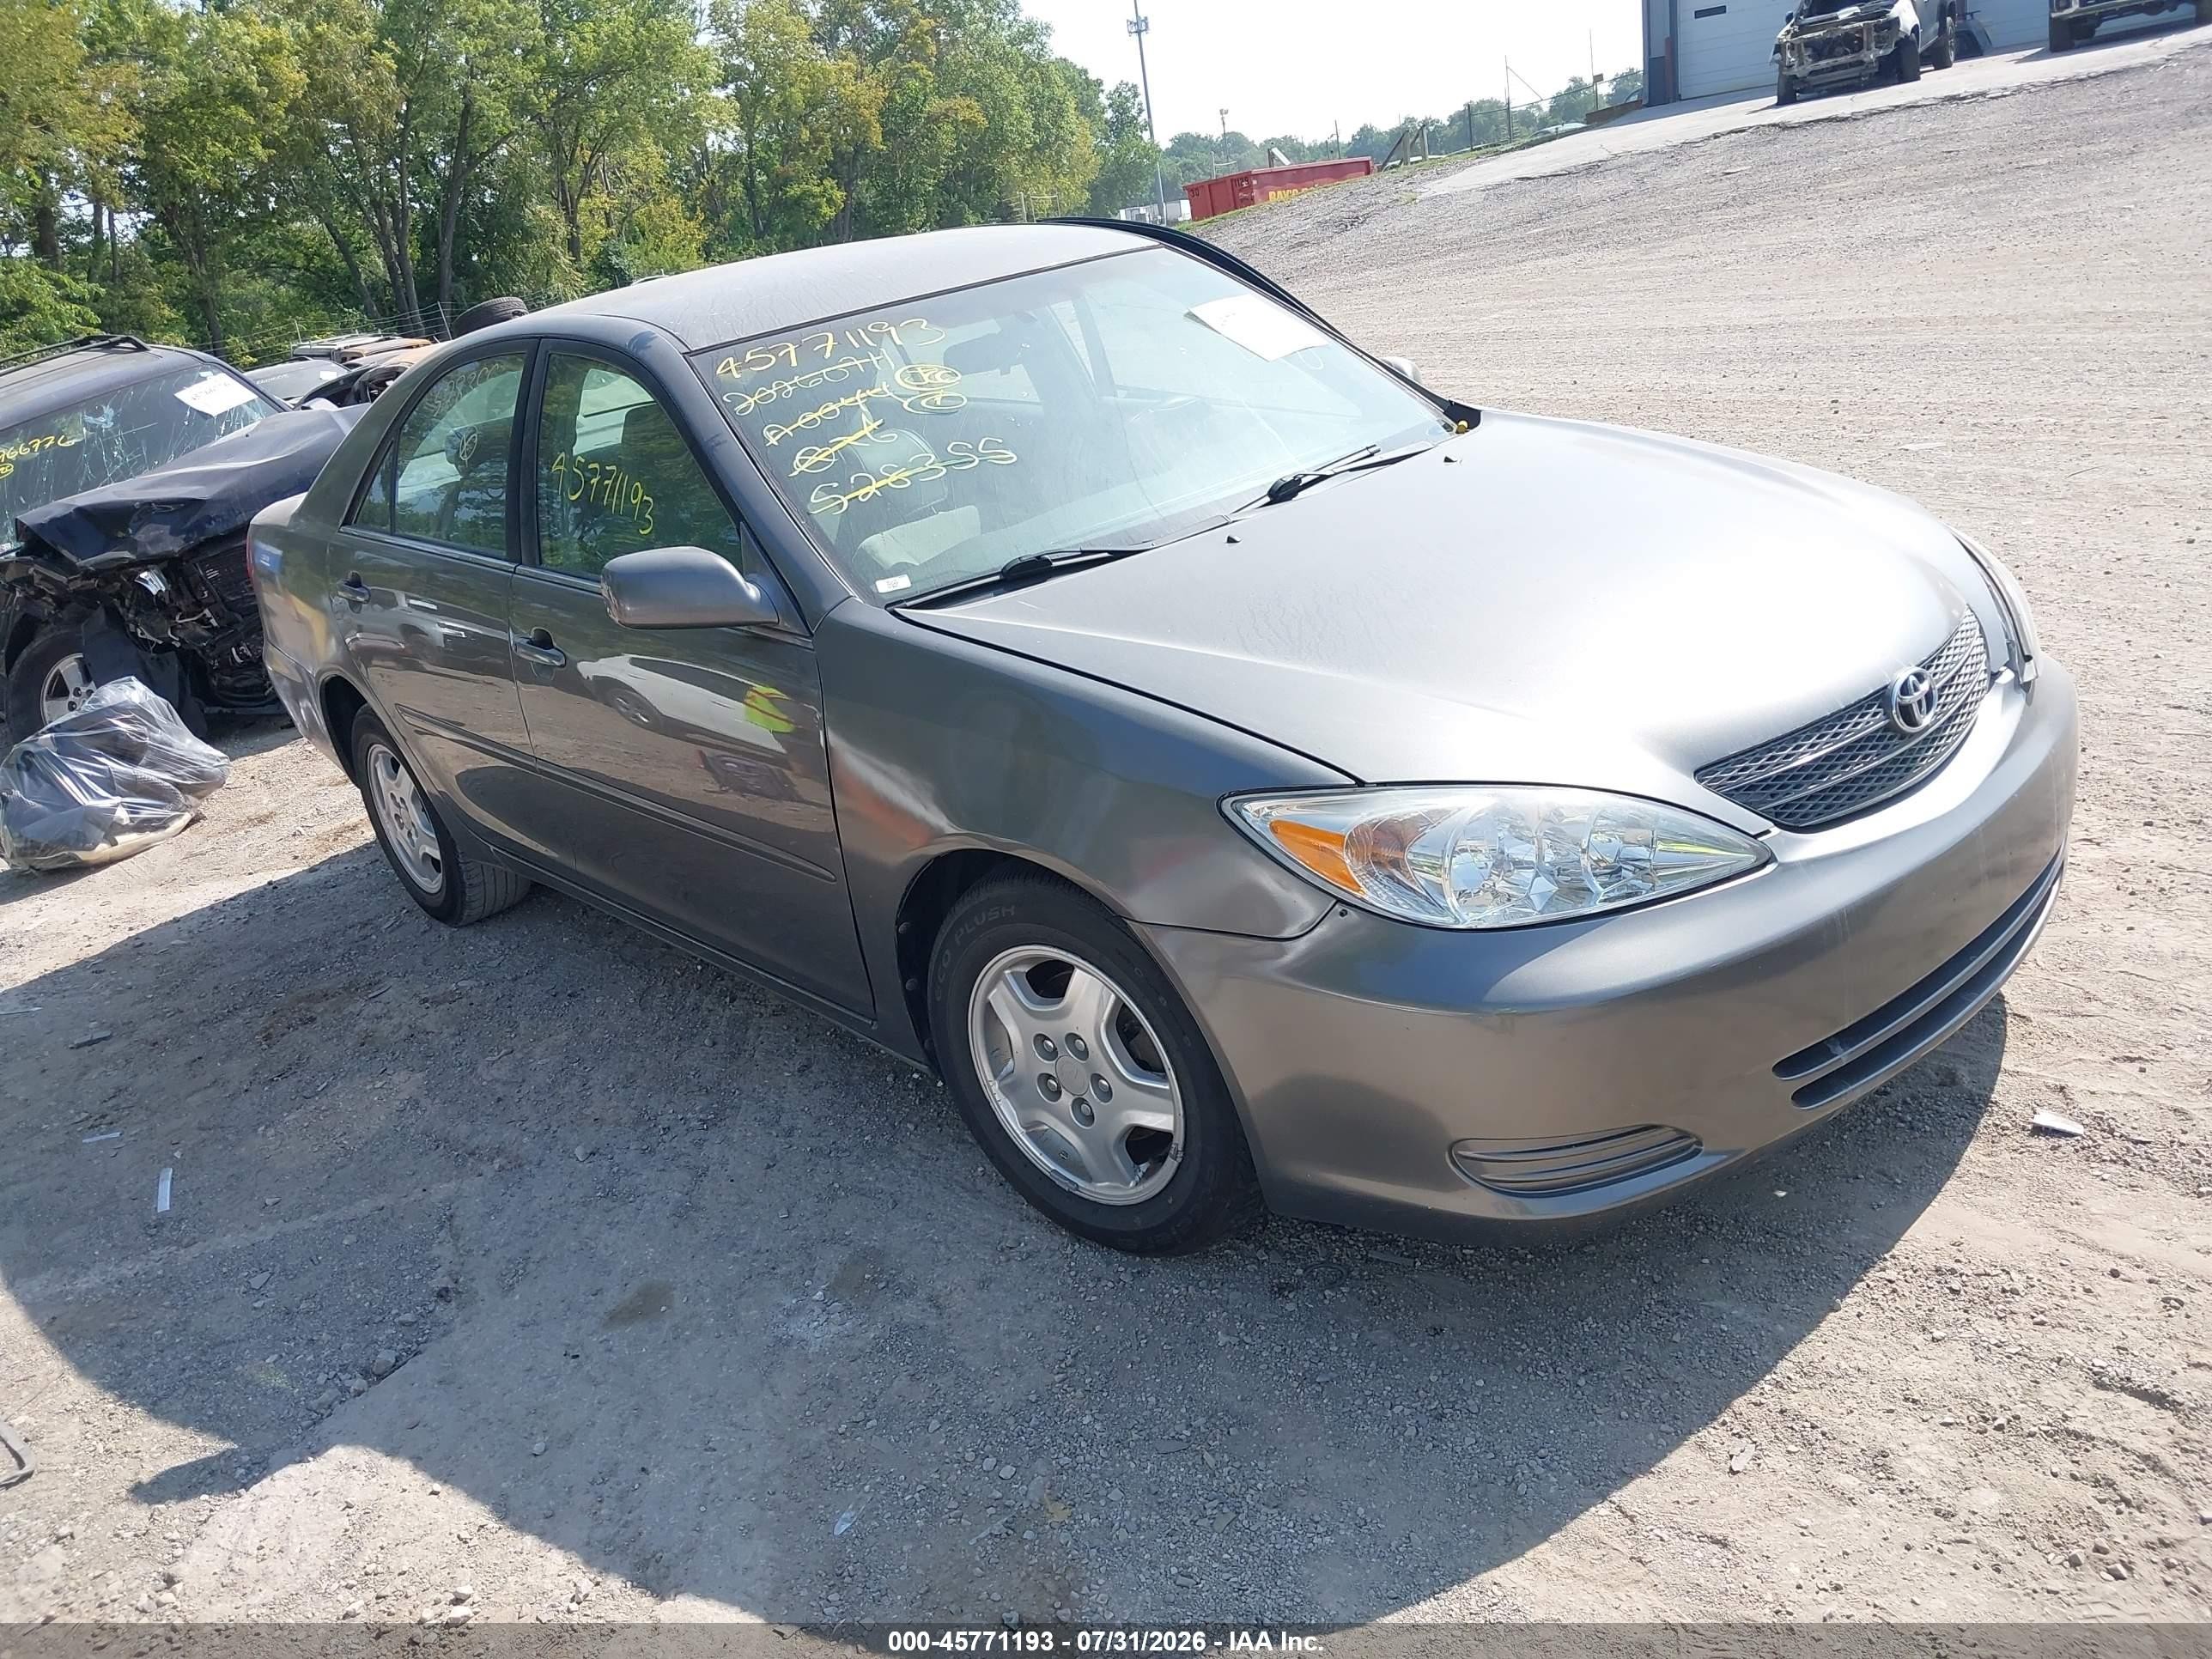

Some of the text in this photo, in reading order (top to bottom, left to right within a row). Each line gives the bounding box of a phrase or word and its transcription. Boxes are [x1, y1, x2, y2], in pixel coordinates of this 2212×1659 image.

[716, 318, 946, 380] 45771193
[551, 452, 653, 535] 45771193
[954, 905, 1015, 945] PLUSH
